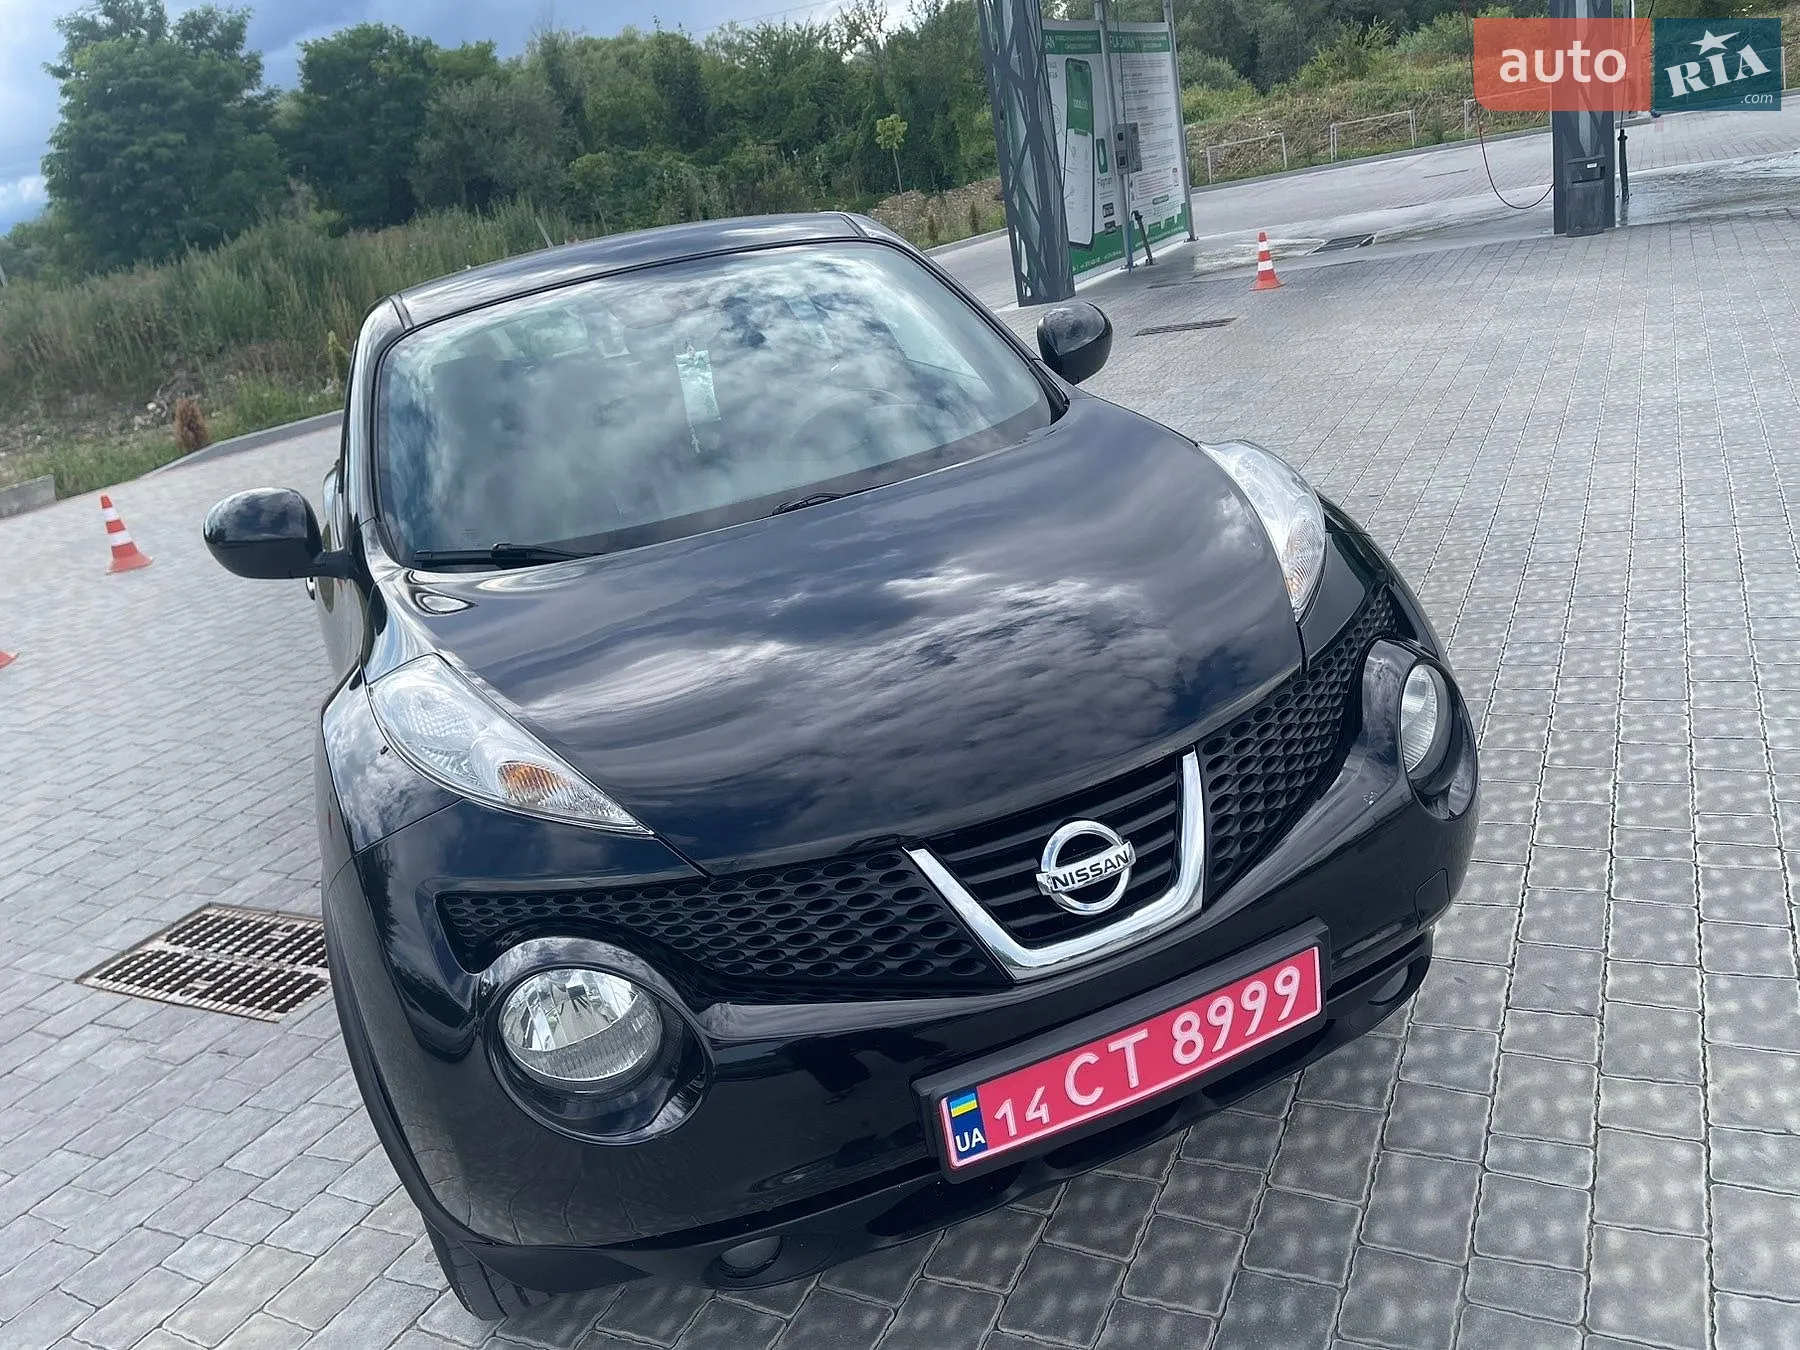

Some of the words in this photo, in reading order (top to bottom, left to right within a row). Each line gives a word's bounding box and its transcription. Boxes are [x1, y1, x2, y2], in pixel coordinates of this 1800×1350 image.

[1052, 851, 1129, 889] NISSAN
[994, 1086, 1050, 1136] 14
[1064, 1031, 1148, 1106] CT
[1172, 966, 1301, 1065] 8999
[955, 1127, 986, 1152] UA
